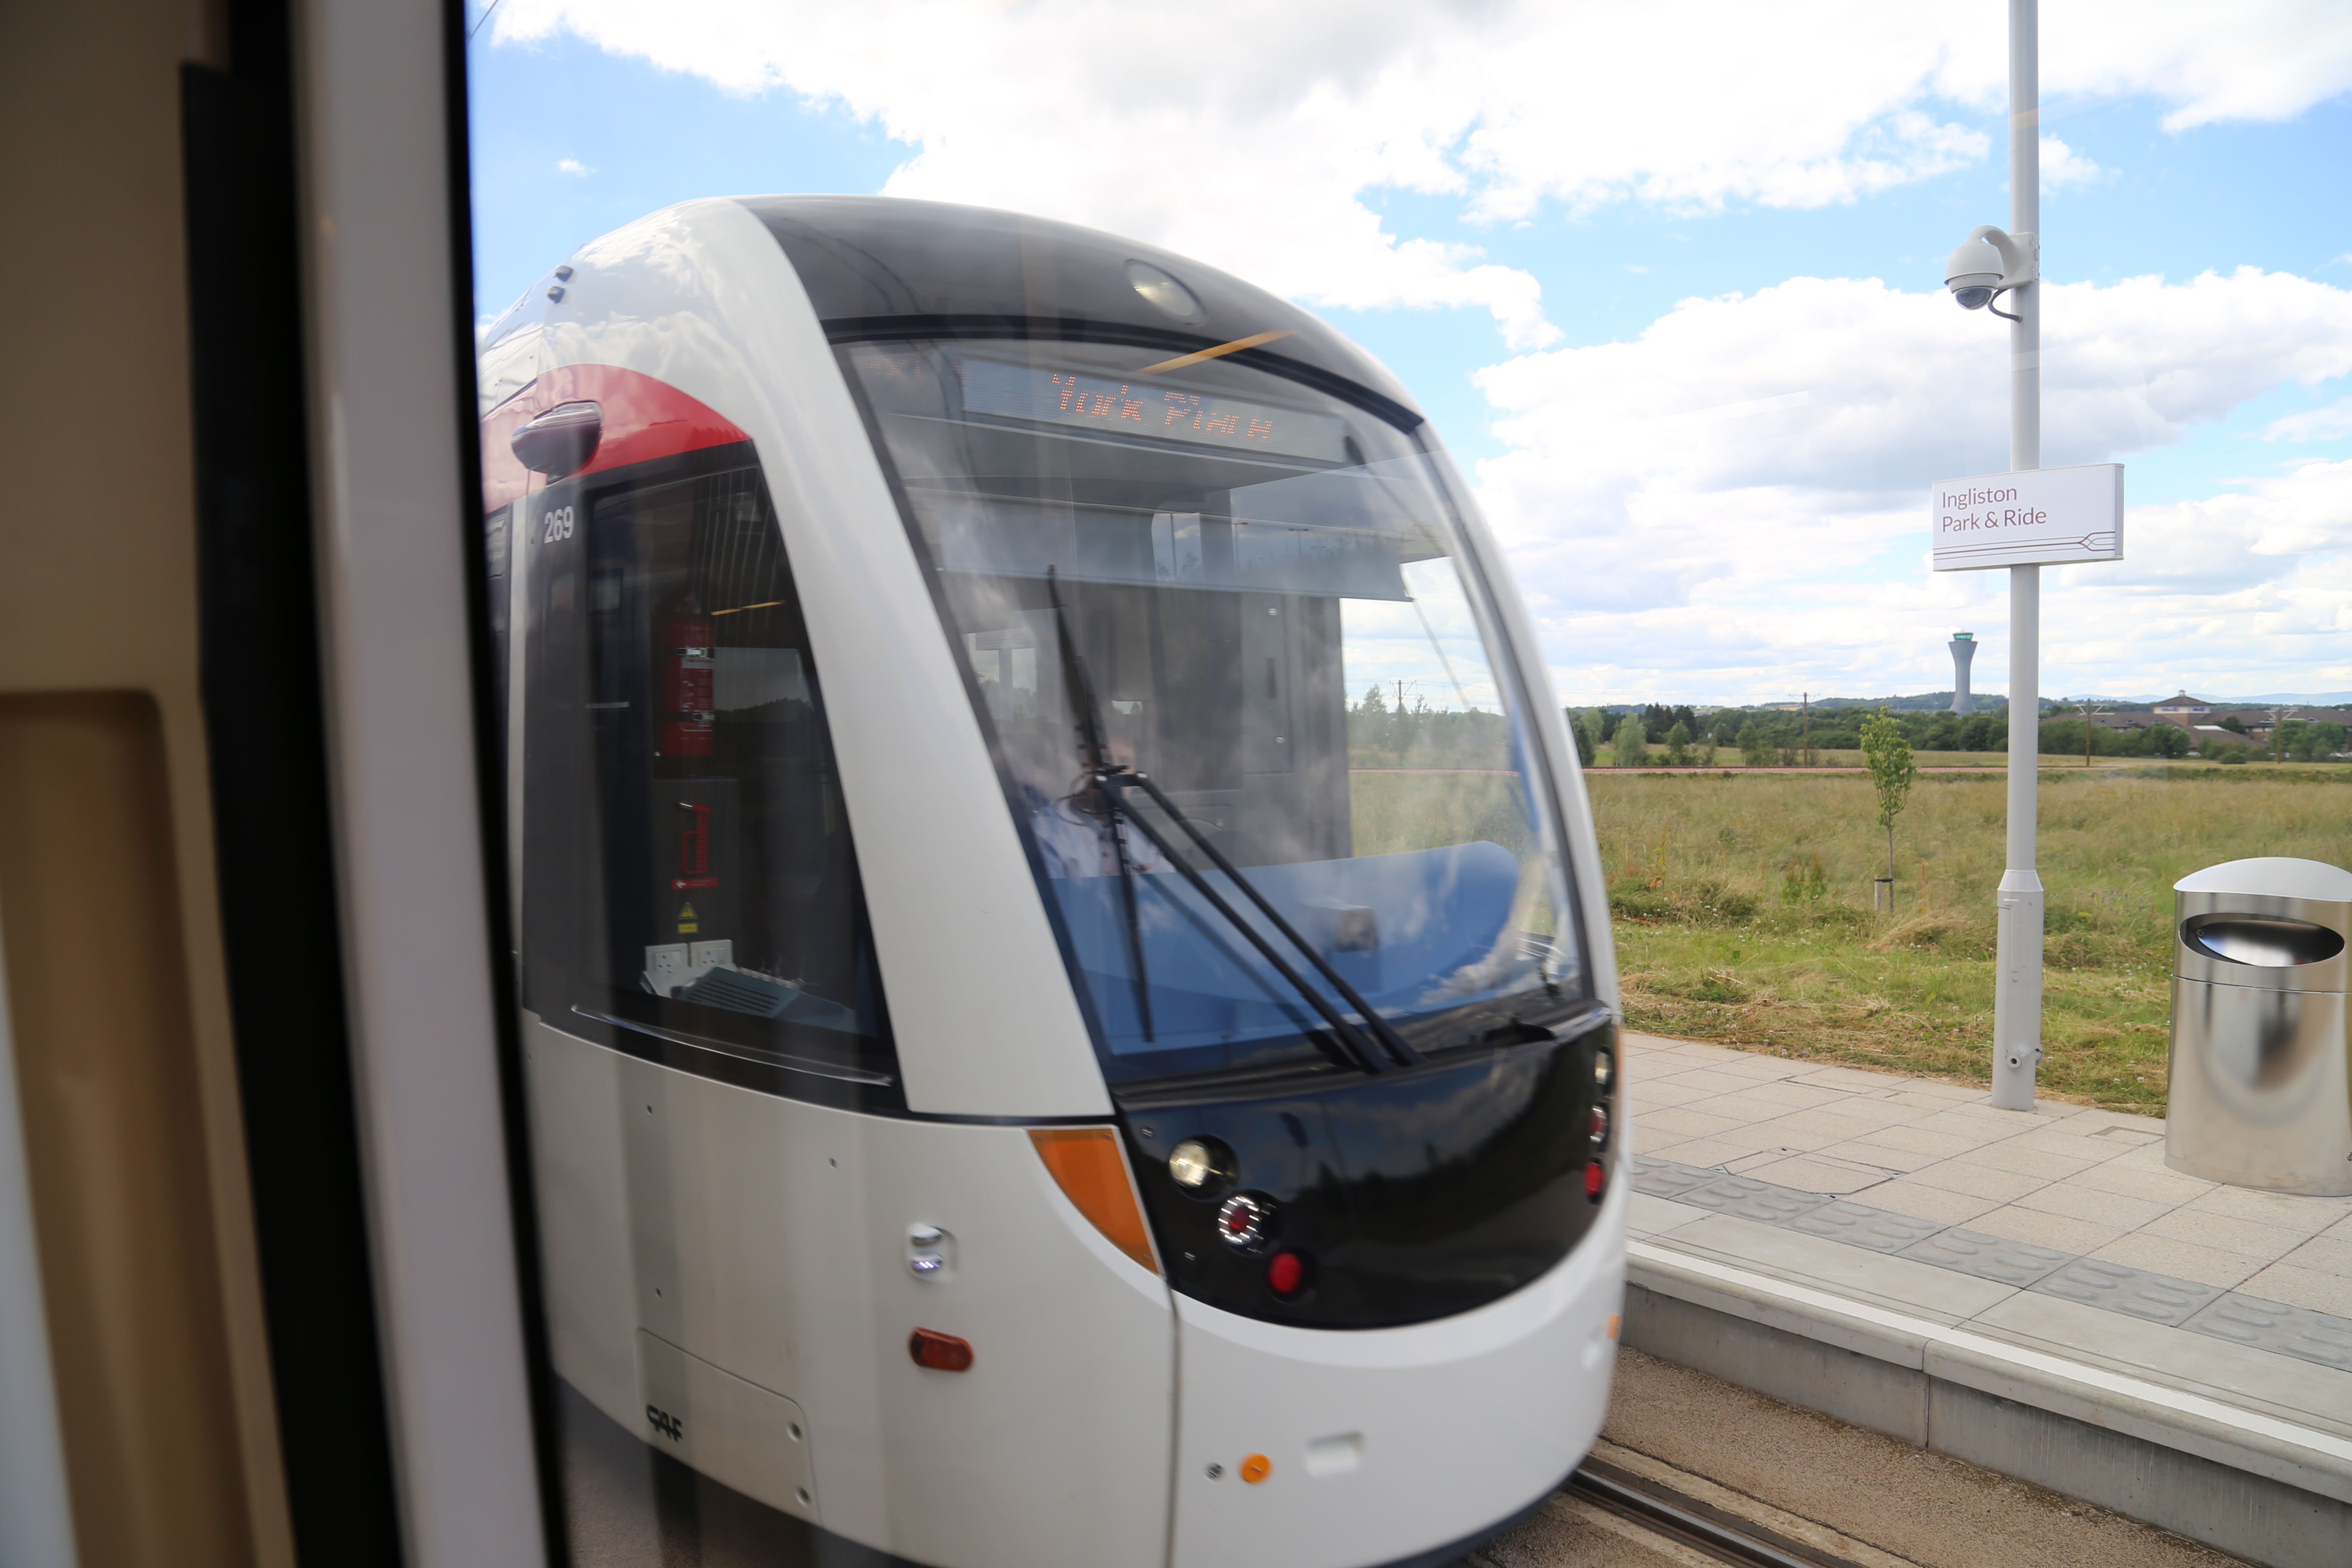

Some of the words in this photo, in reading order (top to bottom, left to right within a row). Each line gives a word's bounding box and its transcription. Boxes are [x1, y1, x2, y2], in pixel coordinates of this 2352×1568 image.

[1052, 373, 1144, 422] York
[1942, 487, 2018, 510] Ingliston
[544, 505, 574, 544] 269
[1942, 512, 1981, 533] Park
[1984, 511, 2000, 528] &
[2003, 507, 2047, 527] Ride
[646, 1404, 683, 1443] CAF
